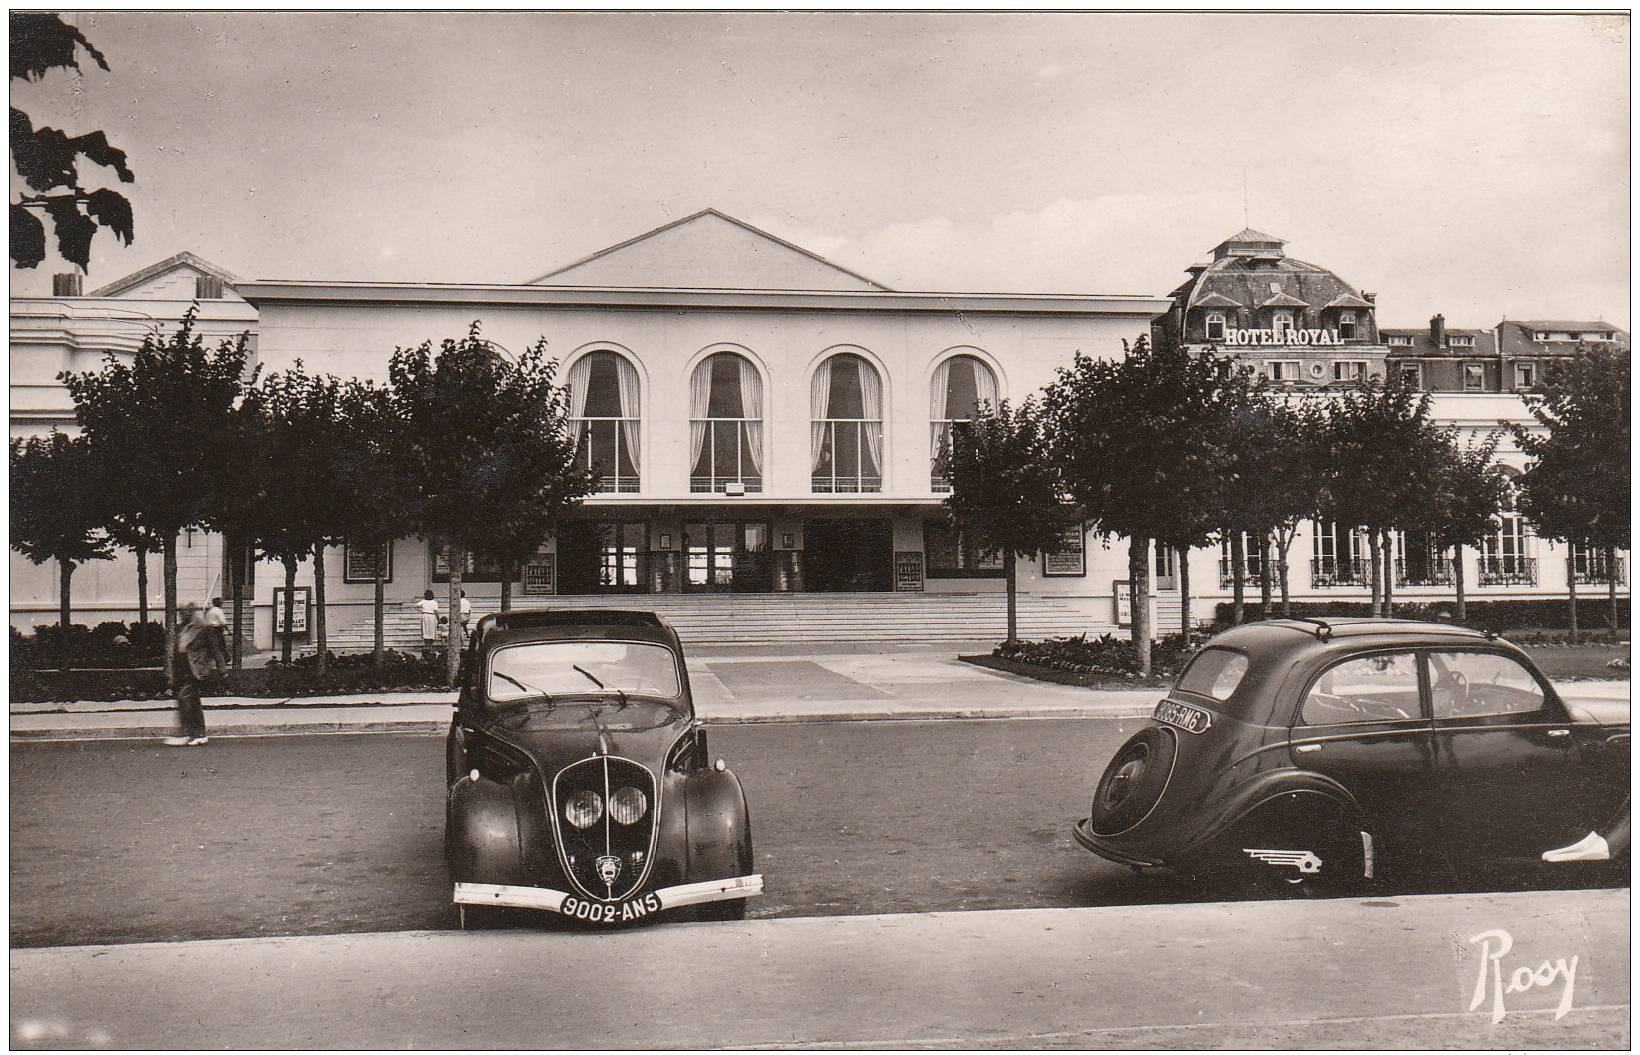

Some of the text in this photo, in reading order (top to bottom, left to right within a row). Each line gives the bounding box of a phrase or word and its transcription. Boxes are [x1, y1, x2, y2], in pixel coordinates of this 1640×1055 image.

[1224, 328, 1345, 346] HOTEL ROYAL
[563, 893, 659, 922] 9002-AN5
